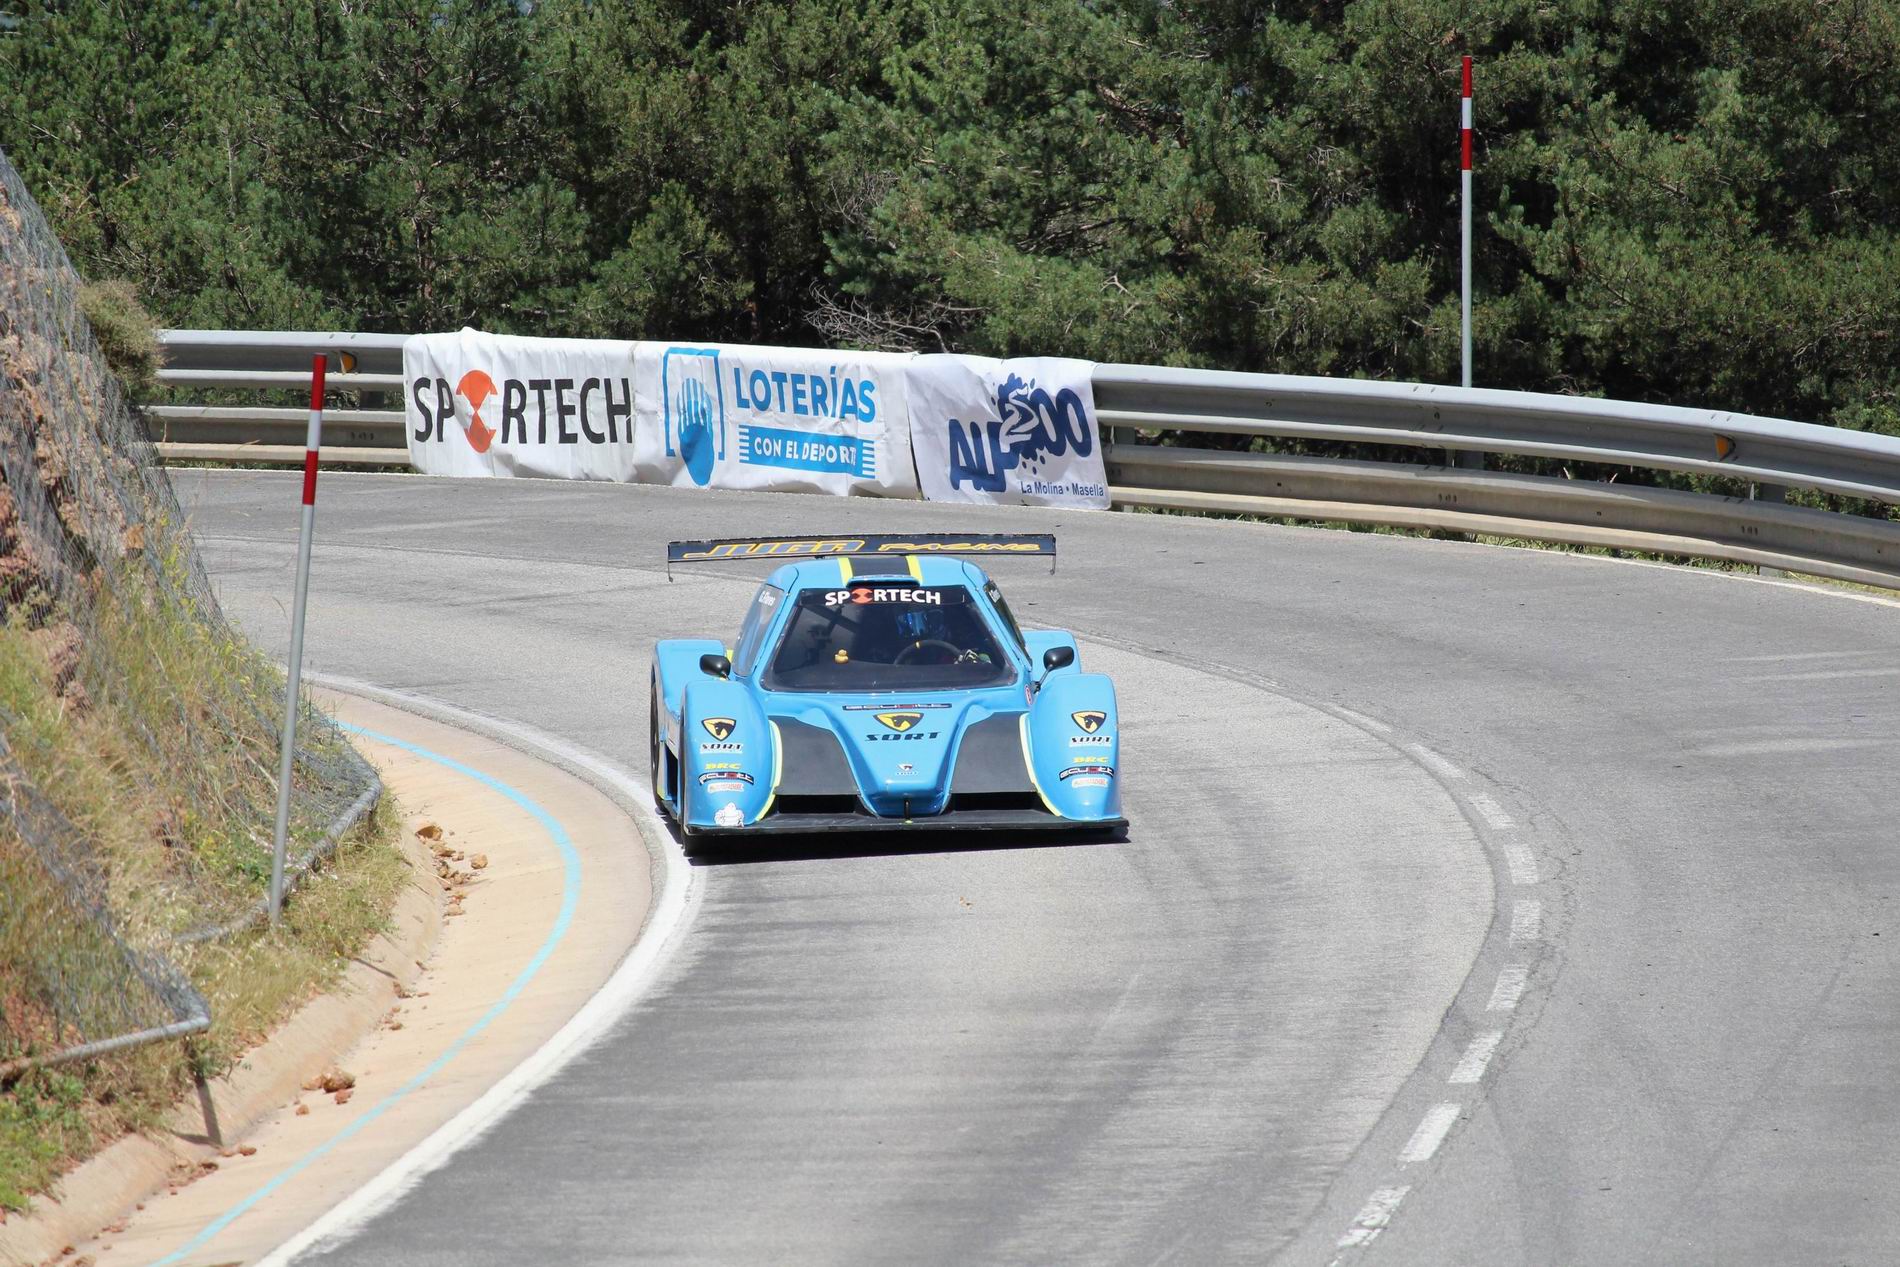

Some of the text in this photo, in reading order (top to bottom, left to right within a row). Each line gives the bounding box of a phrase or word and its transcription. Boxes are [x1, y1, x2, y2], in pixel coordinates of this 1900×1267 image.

[734, 365, 876, 424] LOTERÍAS
[754, 436, 857, 467] CON EL DEPORT
[1020, 481, 1105, 497] La Molina Masella
[878, 542, 1041, 553] RACING
[864, 731, 942, 742] SORT
